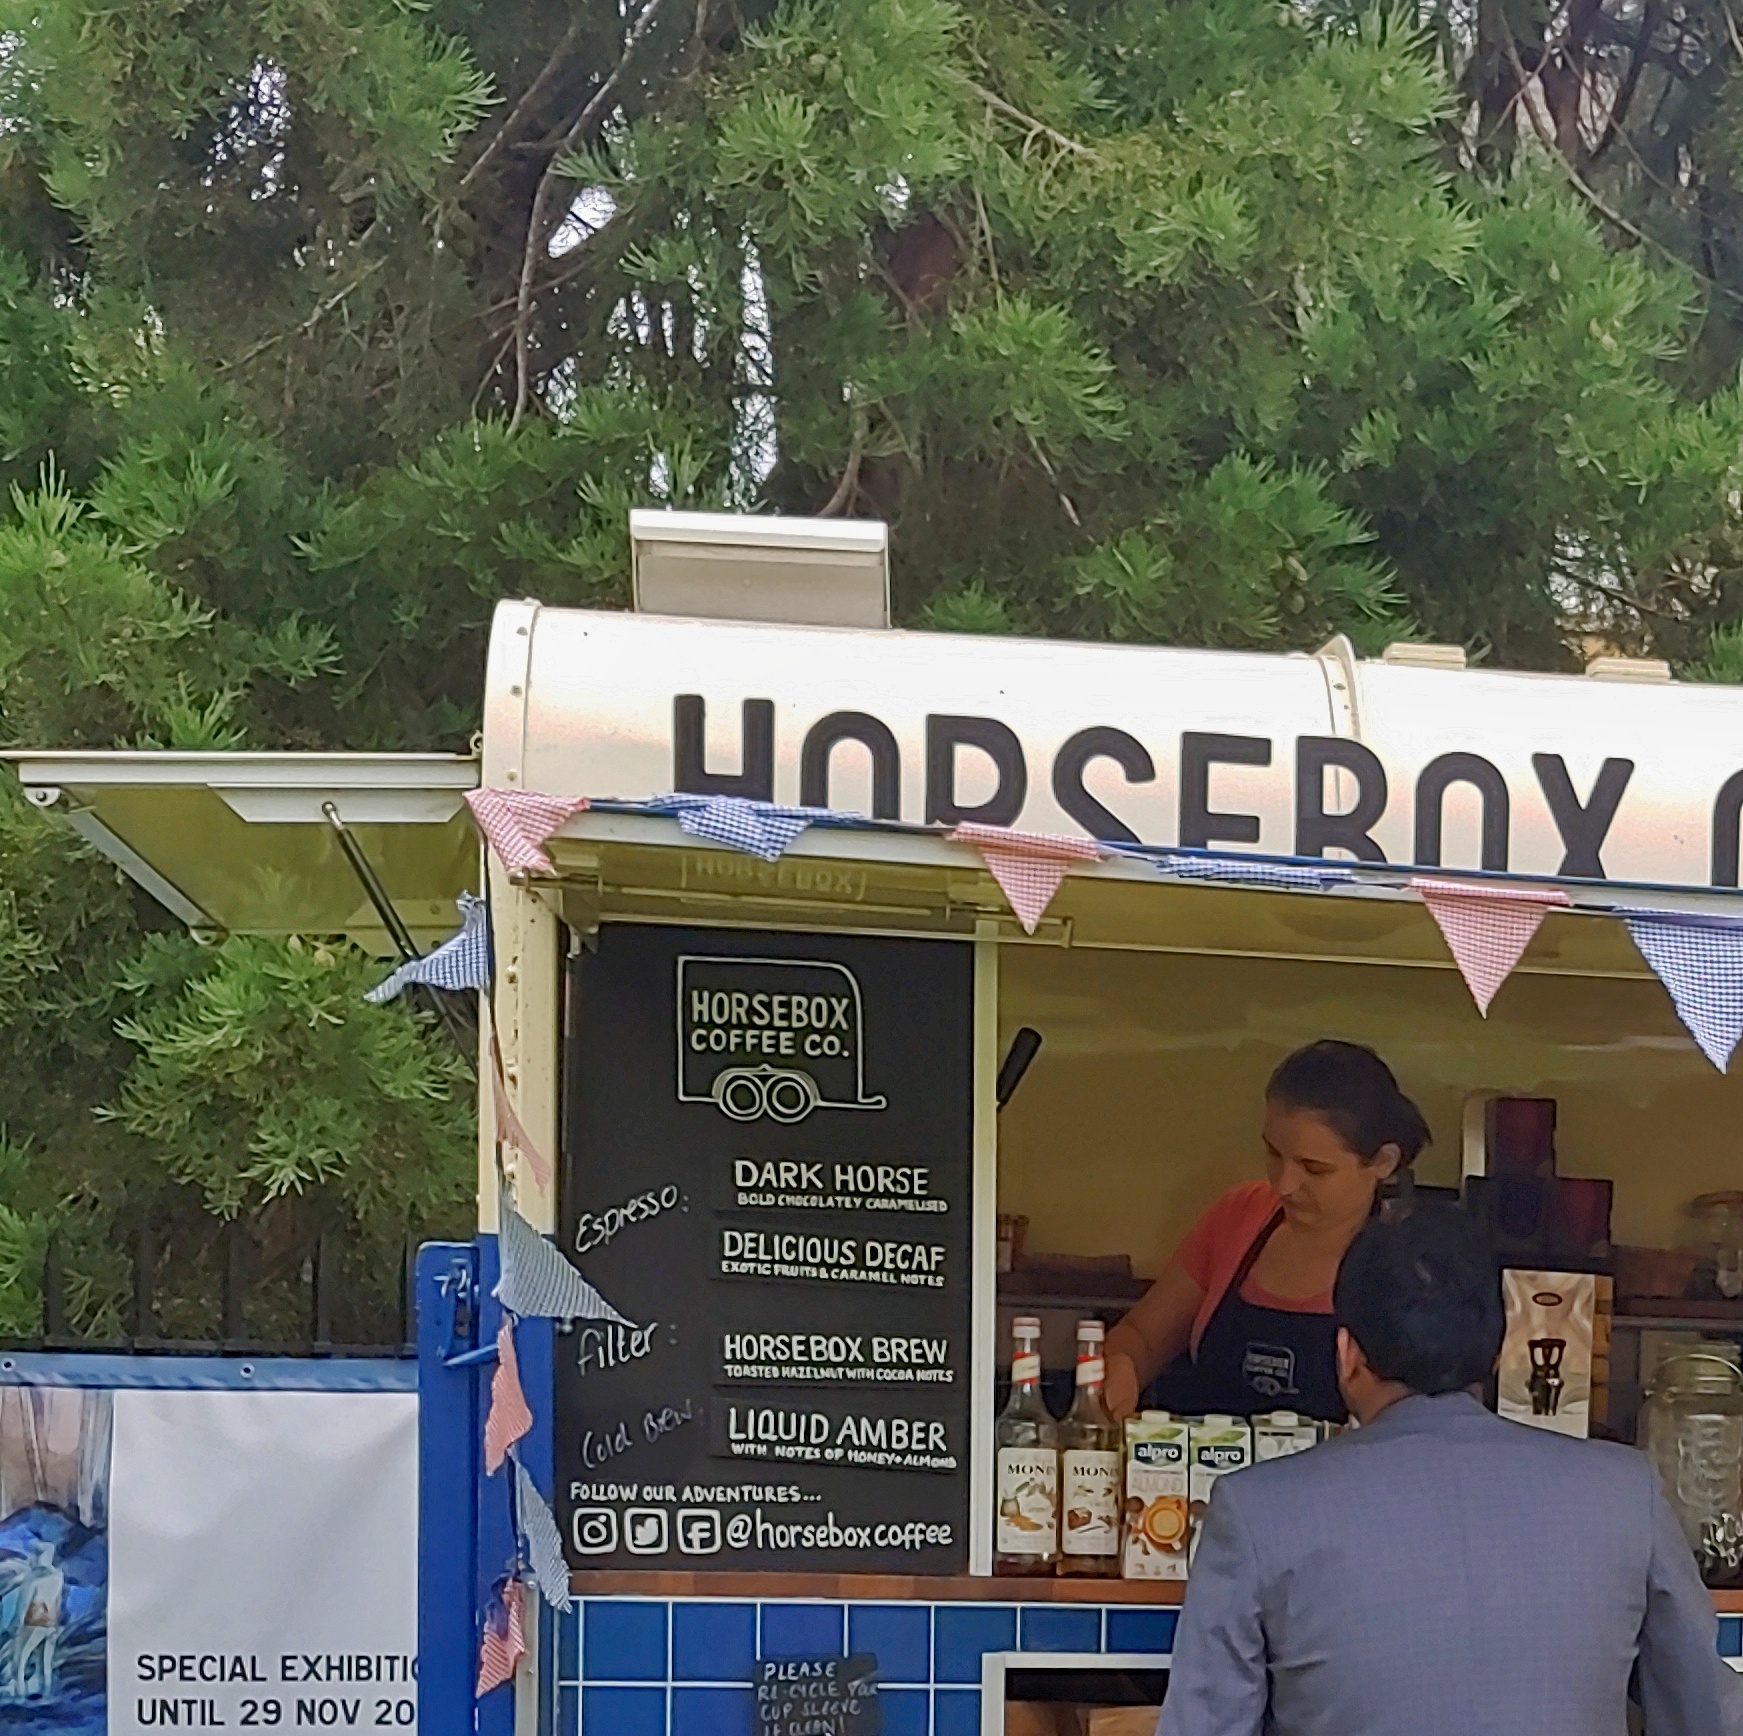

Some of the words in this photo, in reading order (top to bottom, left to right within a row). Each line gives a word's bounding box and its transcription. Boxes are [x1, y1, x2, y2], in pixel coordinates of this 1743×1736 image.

[672, 693, 1635, 881] HORSEBOX
[691, 990, 850, 1030] HORSEBOX
[691, 1029, 796, 1055] COFFEE
[804, 1034, 850, 1057] CO.
[735, 1160, 824, 1190] DARK
[835, 1164, 930, 1196] HORSE
[737, 1192, 775, 1206] BOLD
[723, 1230, 857, 1266] DELICIOUS
[865, 1241, 947, 1271] DECAF
[721, 1261, 772, 1275] EXOTIC
[774, 1263, 818, 1278] FRUITS
[831, 1268, 898, 1284] CARAMEL
[900, 1273, 945, 1287] NOTES
[724, 1334, 864, 1362] HORSEBOX
[872, 1337, 948, 1364] BREW
[724, 1364, 779, 1379] TOASTED
[781, 1365, 844, 1380] HAZELNUT
[846, 1367, 875, 1381] WITH
[876, 1367, 915, 1382] COCOA
[916, 1368, 953, 1383] NOTES
[728, 1407, 830, 1444] LIQUID
[836, 1416, 948, 1452] AMBER
[582, 1421, 634, 1468] Cold
[730, 1442, 767, 1456] WITH
[775, 1445, 821, 1460] NOTES
[824, 1448, 845, 1461] OF
[1137, 1445, 1180, 1461] alpro
[1201, 1448, 1242, 1464] alpro
[570, 1481, 638, 1501] FOLLOW
[643, 1484, 677, 1502] OUR
[137, 1655, 267, 1683] SPECIAL
[764, 1662, 837, 1681] PLEASE
[137, 1699, 225, 1726] UNTIL
[240, 1699, 282, 1726] 29
[297, 1699, 361, 1726] NOV
[375, 1700, 416, 1726] 20
[760, 1702, 793, 1721] CUP
[801, 1699, 861, 1717] SLEEVE
